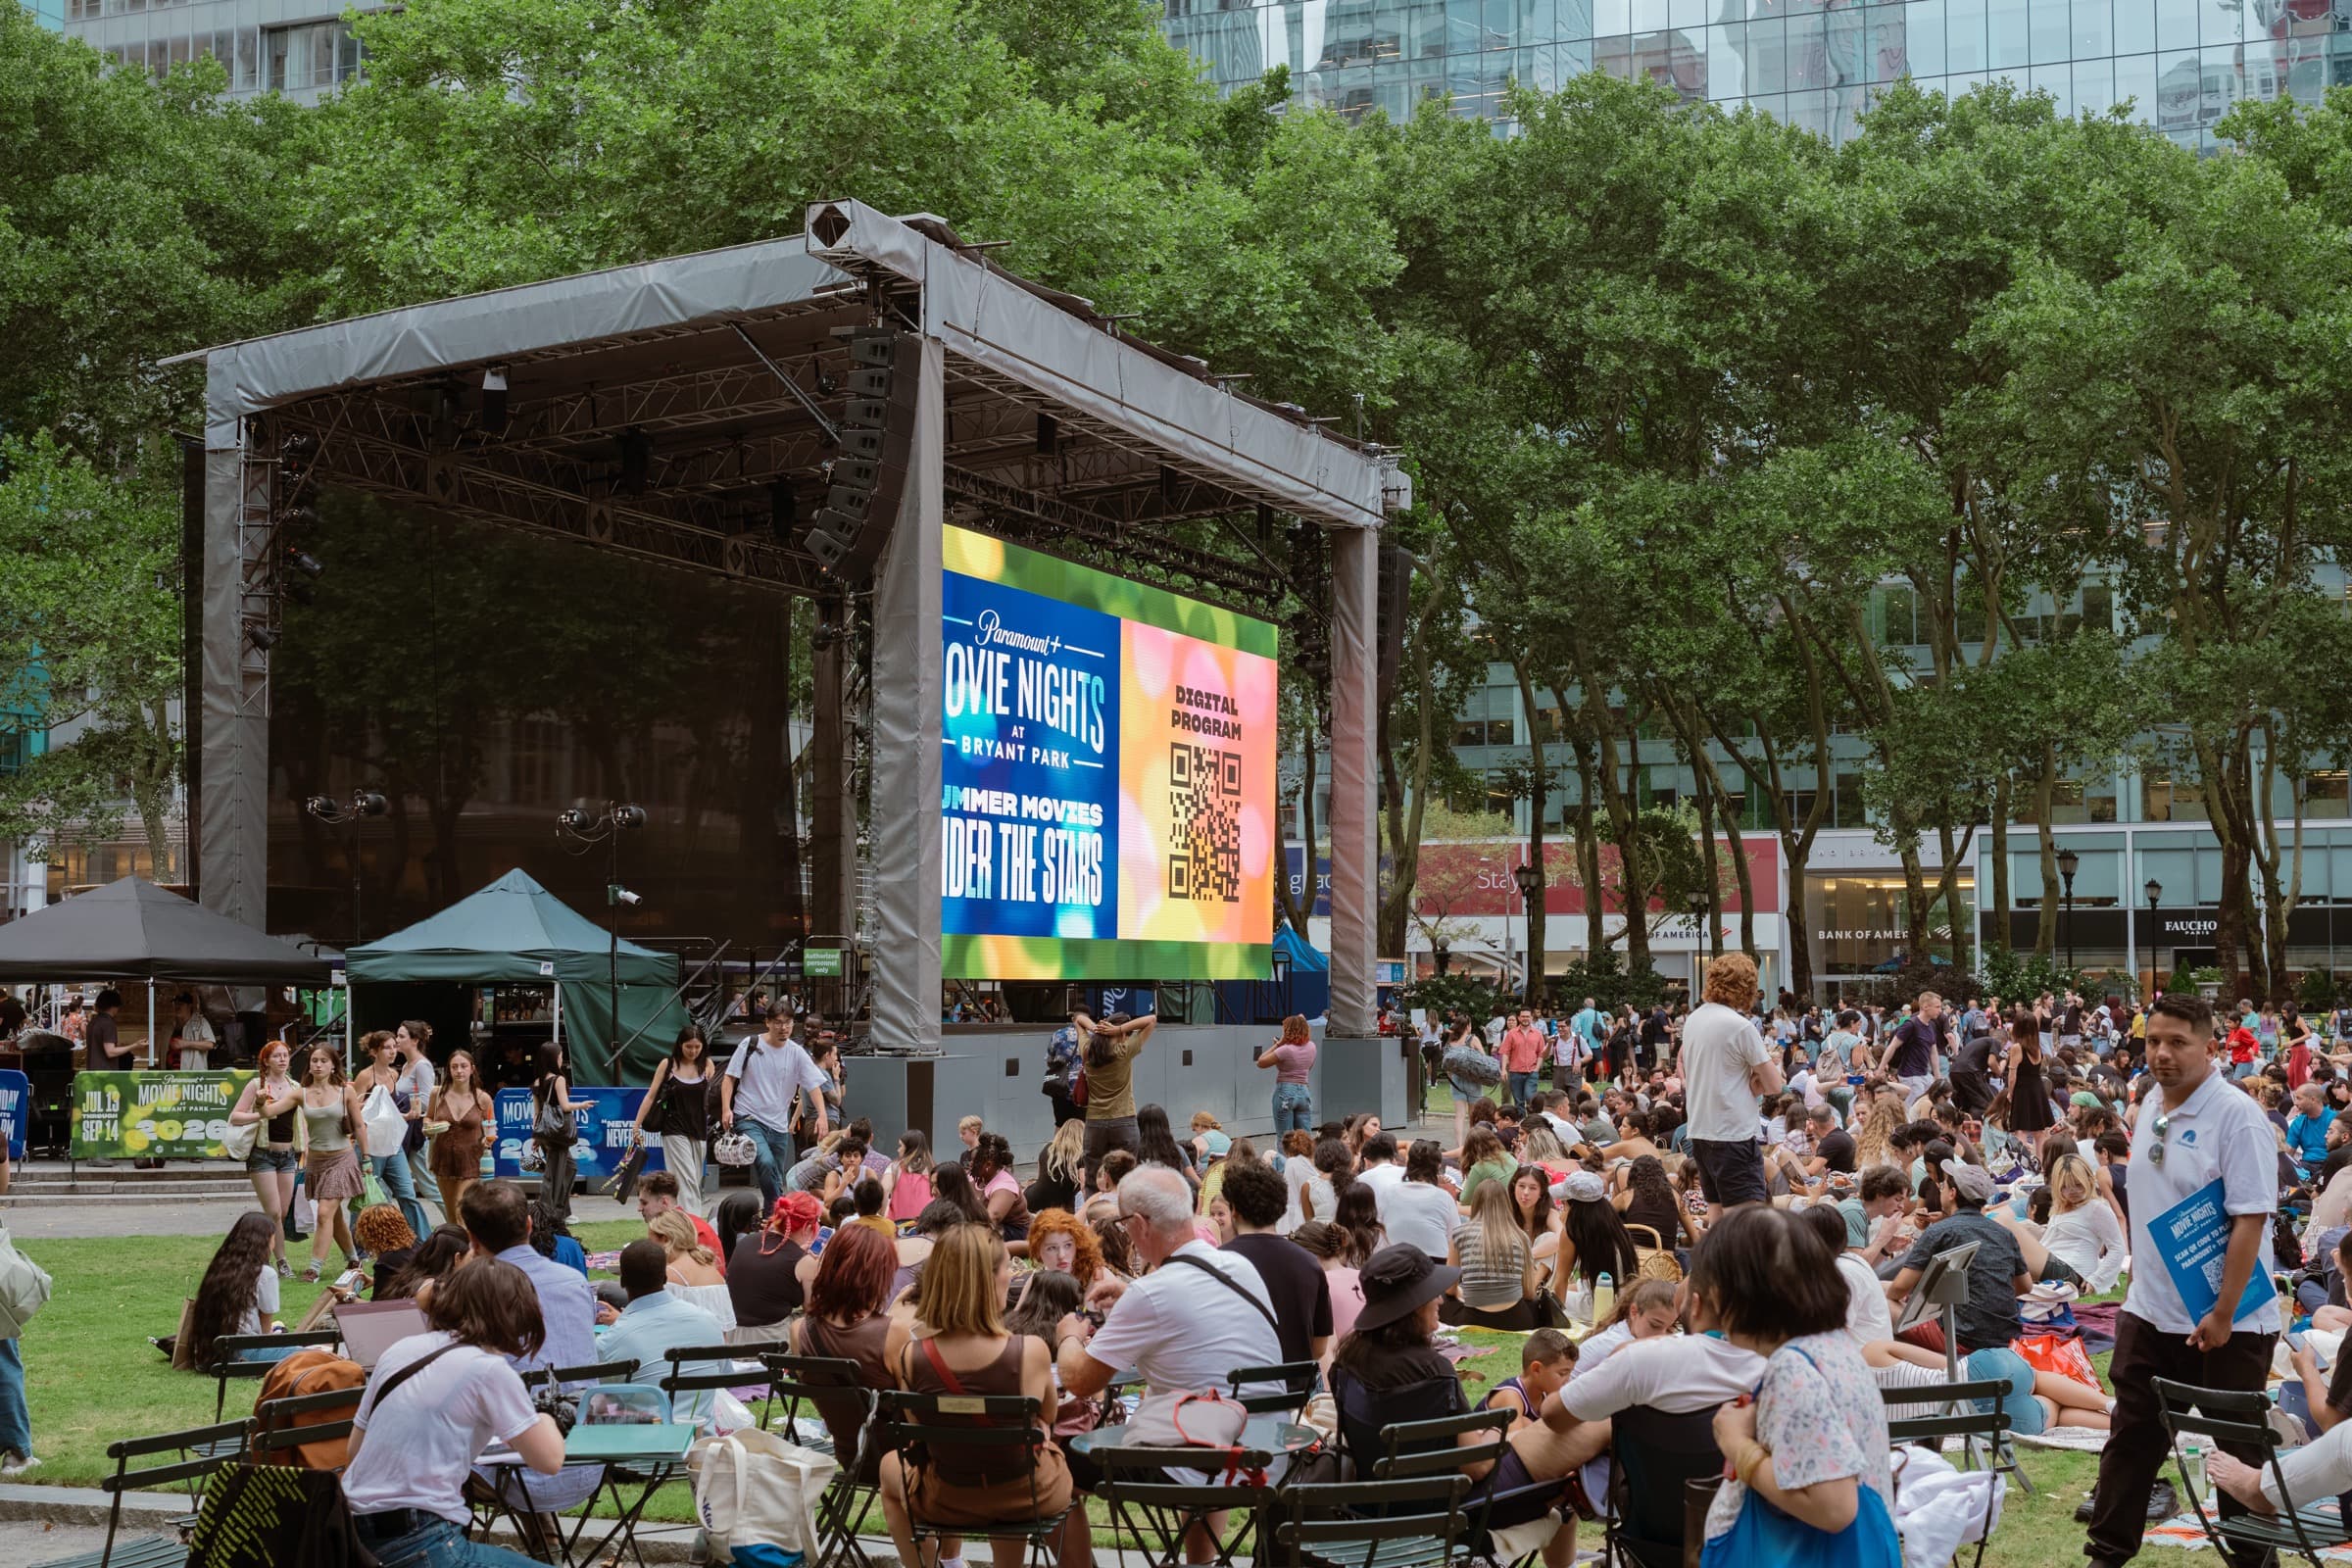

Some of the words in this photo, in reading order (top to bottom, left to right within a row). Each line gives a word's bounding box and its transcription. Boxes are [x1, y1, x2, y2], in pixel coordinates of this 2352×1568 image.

[975, 609, 1061, 656] Paramount+
[944, 642, 1011, 717] OVIE
[1017, 657, 1105, 755] NIGHTS
[1175, 685, 1239, 716] DIGITAL
[1011, 725, 1025, 738] AT
[1171, 710, 1242, 741] PROGRAM
[961, 735, 1026, 762] BRYANT
[1032, 747, 1070, 769] PARK
[942, 784, 1018, 817] UMMER
[1021, 795, 1103, 827] MOVIES
[942, 815, 993, 900] DER
[999, 822, 1038, 902] THE
[1043, 827, 1102, 906] STARS
[1477, 868, 1519, 894] Stay
[1818, 930, 1852, 940] BANK
[1855, 930, 1872, 940] OF
[2165, 920, 2218, 931] FAUCHO
[82, 1091, 103, 1112] JUL
[138, 1084, 179, 1106] MOVIE
[182, 1084, 227, 1106] NIGHTS
[82, 1120, 103, 1142] SEP
[105, 1120, 119, 1142] 14
[135, 1118, 230, 1142] 2026
[2171, 1214, 2193, 1240] MOVIE
[2190, 1201, 2217, 1223] NIGHTS
[2175, 1250, 2189, 1262] SCAN
[2196, 1235, 2211, 1248] CODE
[2211, 1229, 2220, 1238] TO
